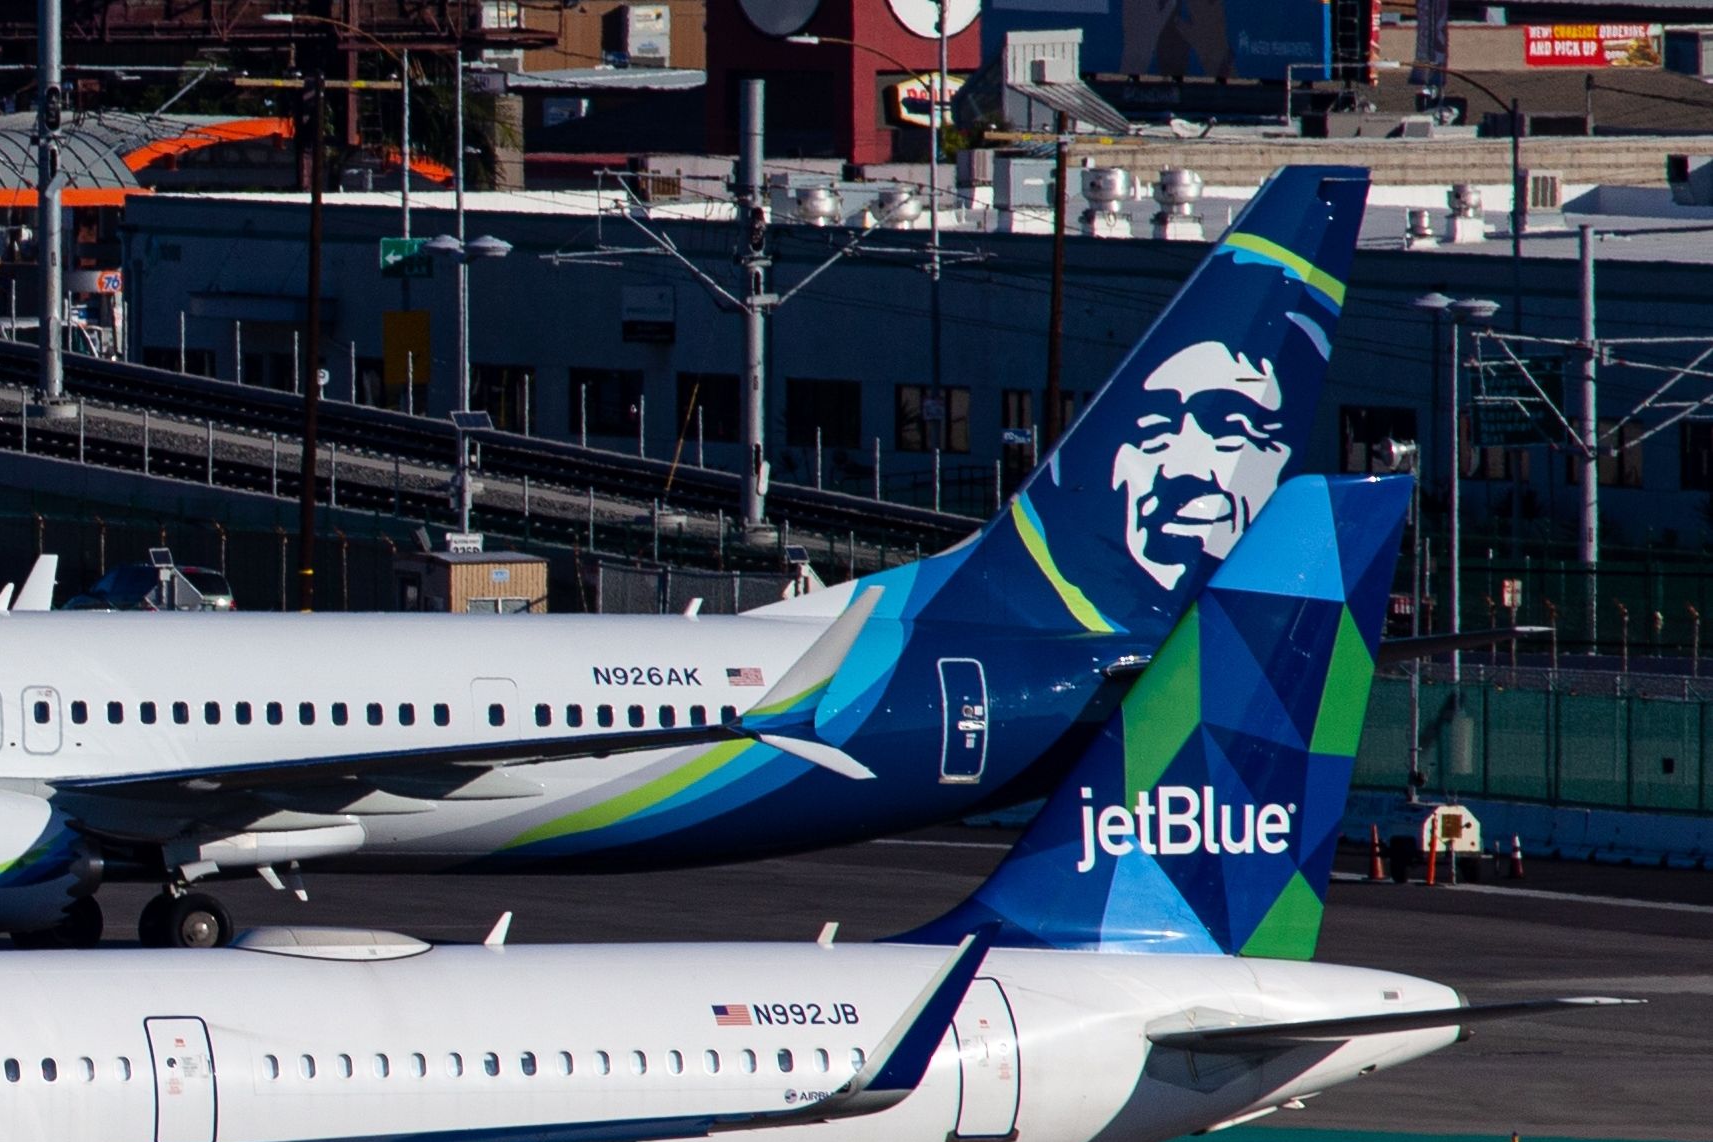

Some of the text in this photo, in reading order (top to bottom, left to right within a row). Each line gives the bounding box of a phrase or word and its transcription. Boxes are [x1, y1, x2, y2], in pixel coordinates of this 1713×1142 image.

[1599, 25, 1646, 38] ORDERING
[1530, 41, 1552, 56] AND
[1555, 41, 1581, 56] PICK
[1582, 41, 1597, 56] UP
[104, 275, 120, 290] 76
[592, 666, 702, 686] N926AK
[1077, 786, 1290, 873] jetBlue
[753, 1003, 859, 1025] N992JB
